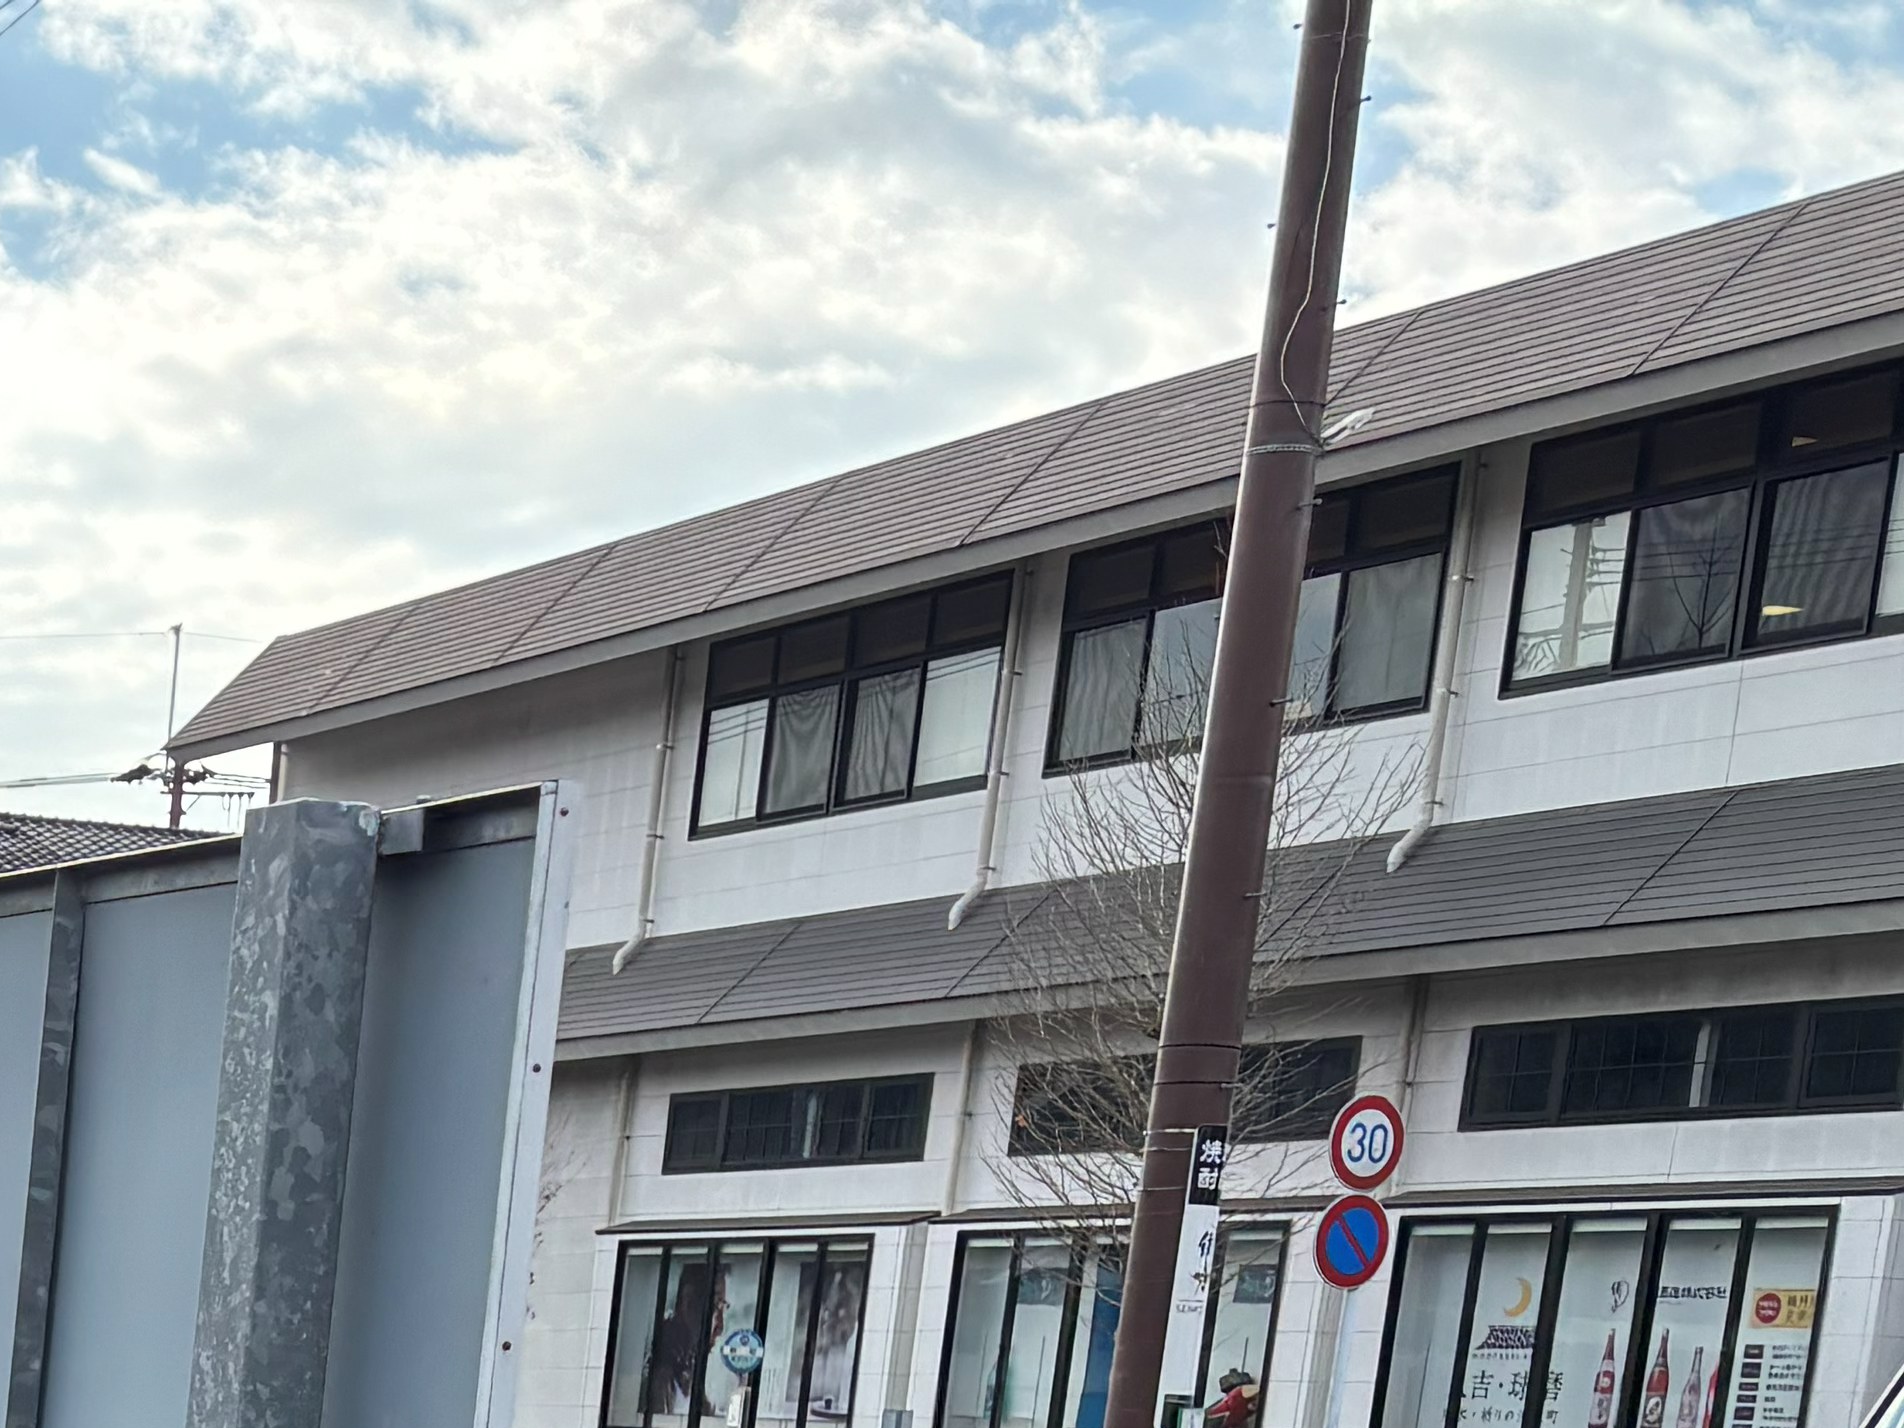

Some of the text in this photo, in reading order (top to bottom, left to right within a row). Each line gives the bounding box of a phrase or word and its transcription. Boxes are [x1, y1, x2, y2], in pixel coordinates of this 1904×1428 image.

[1347, 1122, 1388, 1164] 30
[1197, 1138, 1223, 1191] 焼酎
[1460, 1370, 1564, 1402] 吉・球磨
